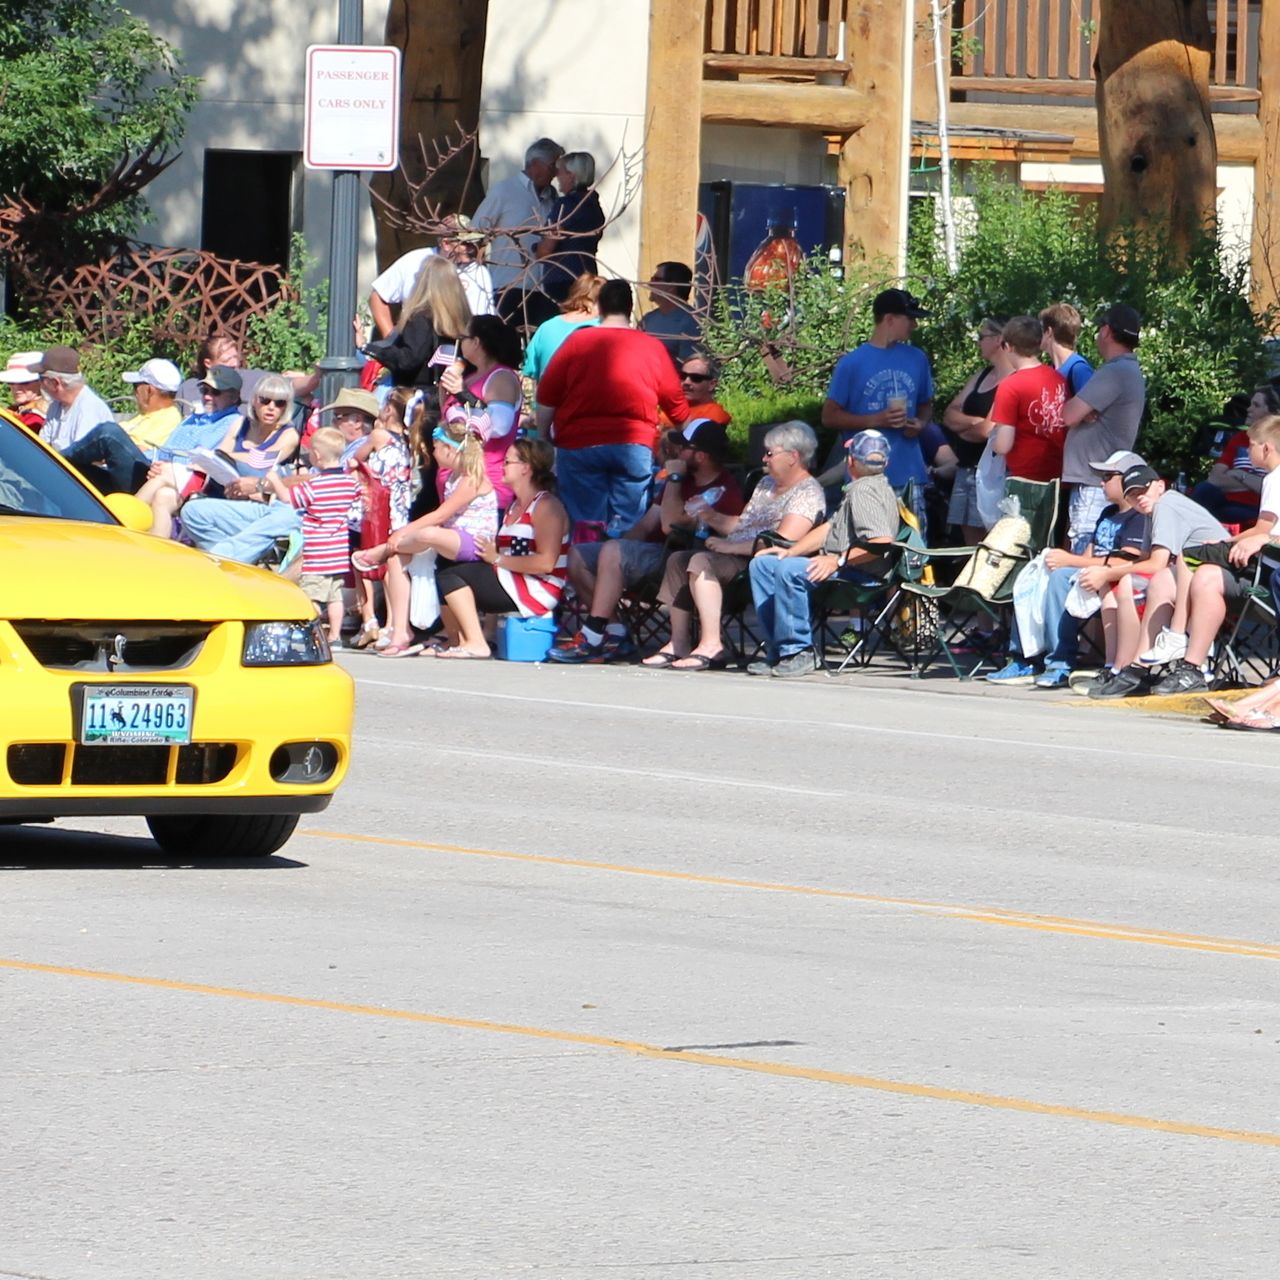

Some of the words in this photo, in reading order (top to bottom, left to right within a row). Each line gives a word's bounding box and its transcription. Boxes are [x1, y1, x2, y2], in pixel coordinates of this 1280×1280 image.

[317, 70, 389, 81] PASSENGER
[318, 98, 350, 108] CARS
[353, 99, 387, 109] ONLY
[110, 688, 150, 696] Columbine
[151, 688, 168, 696] Ford
[88, 703, 106, 729] 11
[130, 703, 186, 729] 24963
